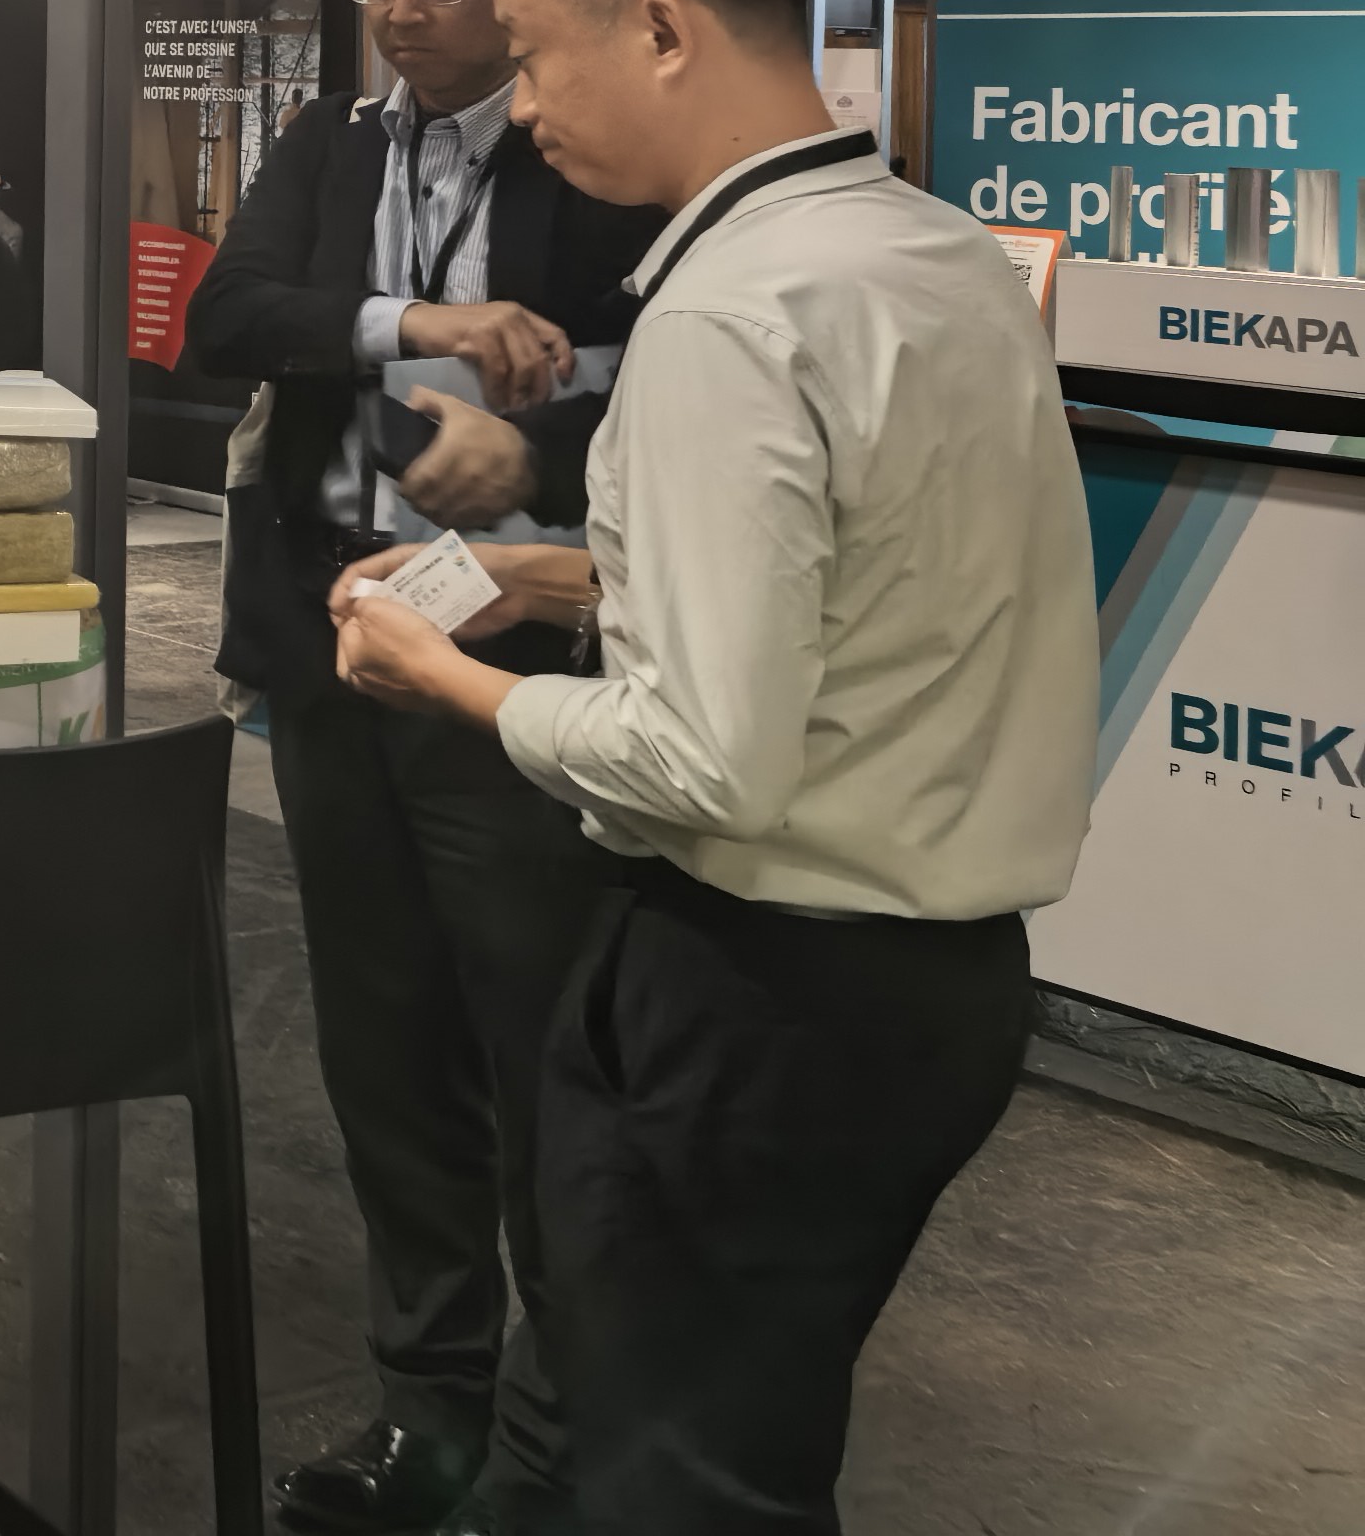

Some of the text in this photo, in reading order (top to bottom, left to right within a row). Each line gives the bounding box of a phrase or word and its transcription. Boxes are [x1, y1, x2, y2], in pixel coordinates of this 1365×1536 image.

[145, 20, 258, 34] C'EST AVEC L'UNSFA
[144, 42, 236, 58] QUE SE DESSINE
[144, 64, 210, 79] L'AVENIR DE
[143, 86, 254, 102] NOTRE PROFESSION
[972, 86, 1299, 150] Fabricant
[970, 165, 1048, 222] de
[1159, 306, 1359, 357] BIEKAPA
[1171, 692, 1365, 788] BIEK
